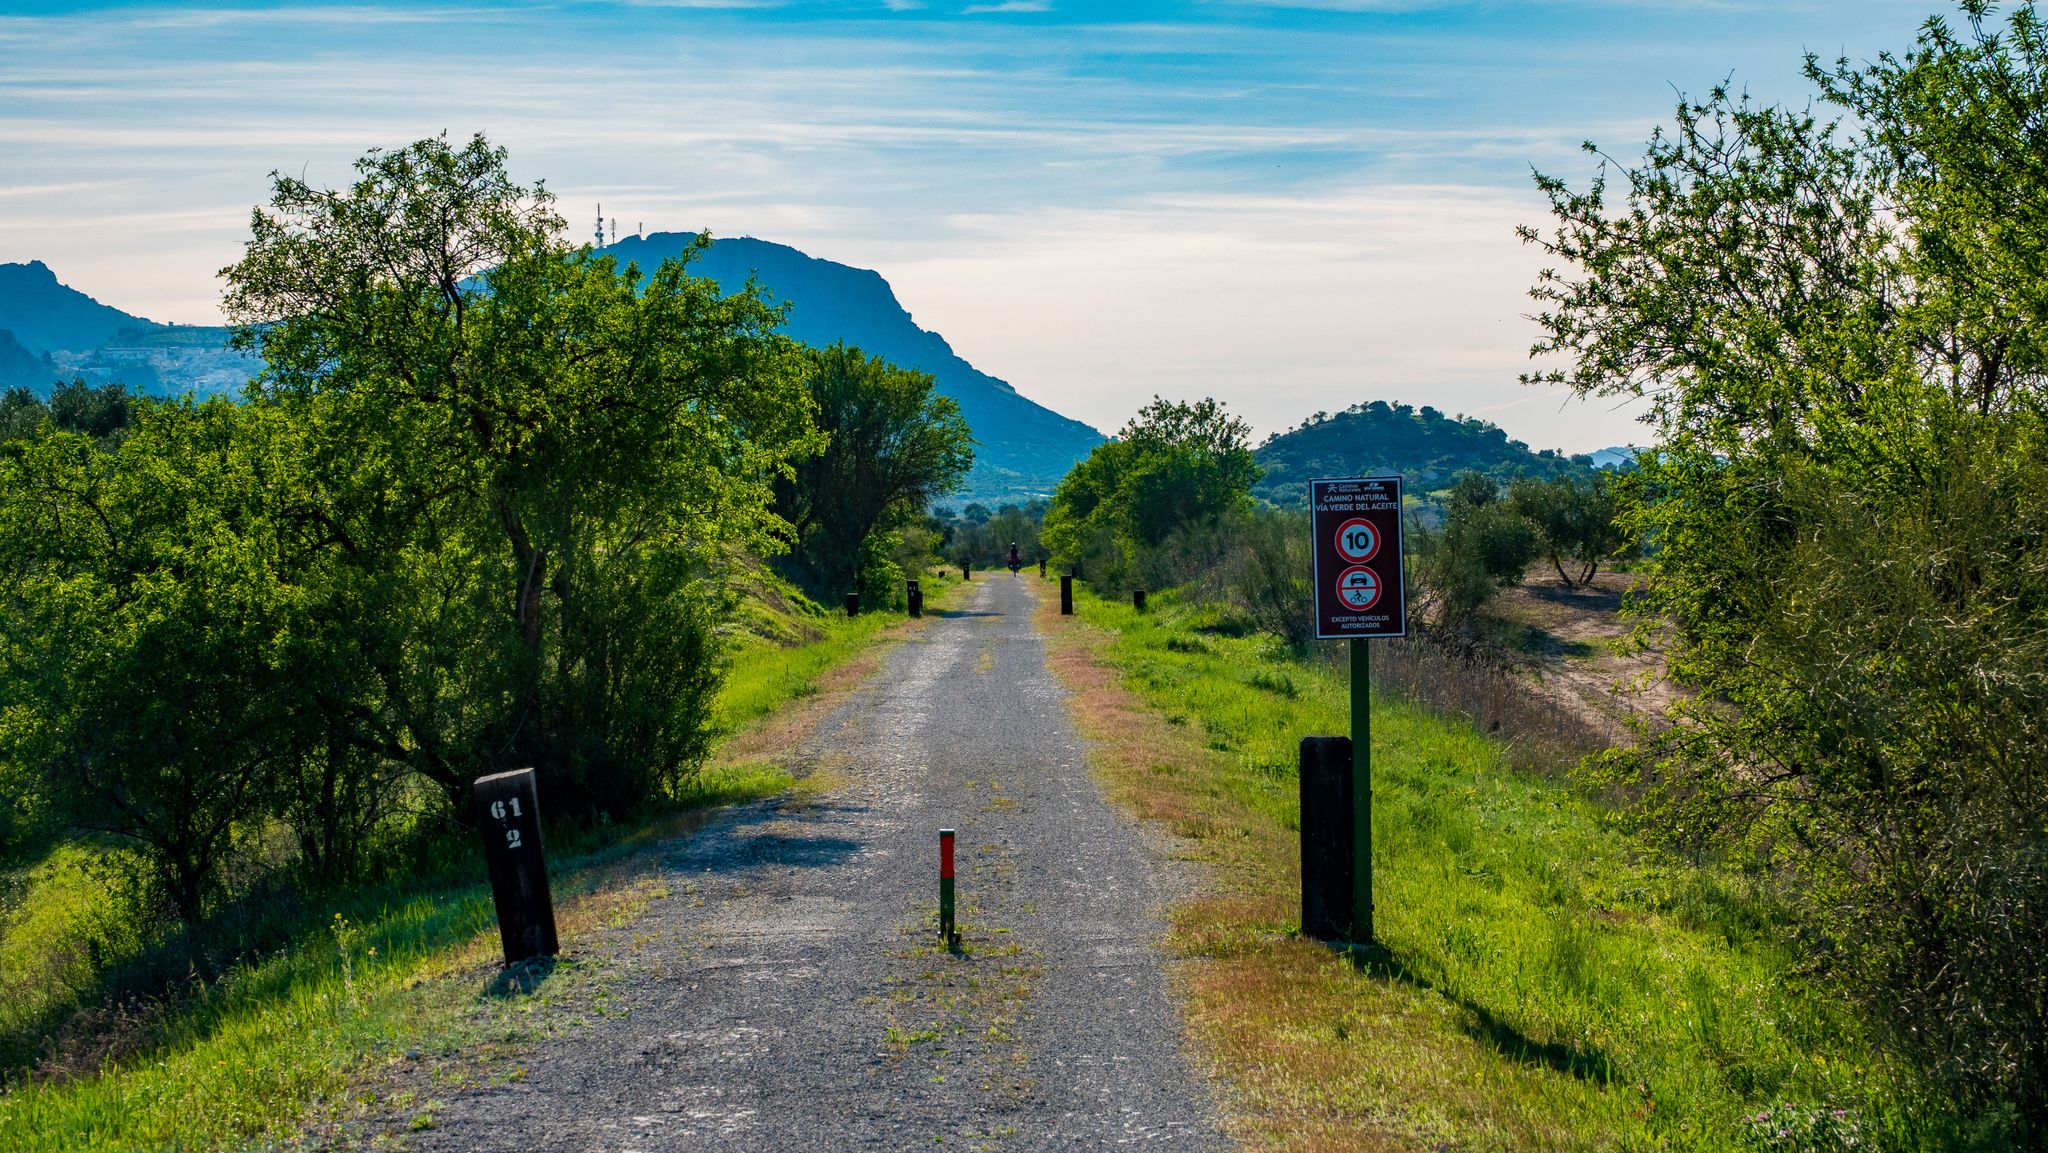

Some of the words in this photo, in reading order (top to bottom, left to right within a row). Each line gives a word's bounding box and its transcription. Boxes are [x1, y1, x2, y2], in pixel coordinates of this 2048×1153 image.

[1355, 493, 1389, 501] NATURAL
[1316, 503, 1328, 511] VÍA
[1355, 503, 1370, 511] DEL
[1371, 502, 1398, 510] ACEITE
[1346, 532, 1369, 550] 10
[491, 797, 522, 819] 61
[506, 829, 522, 849] 2
